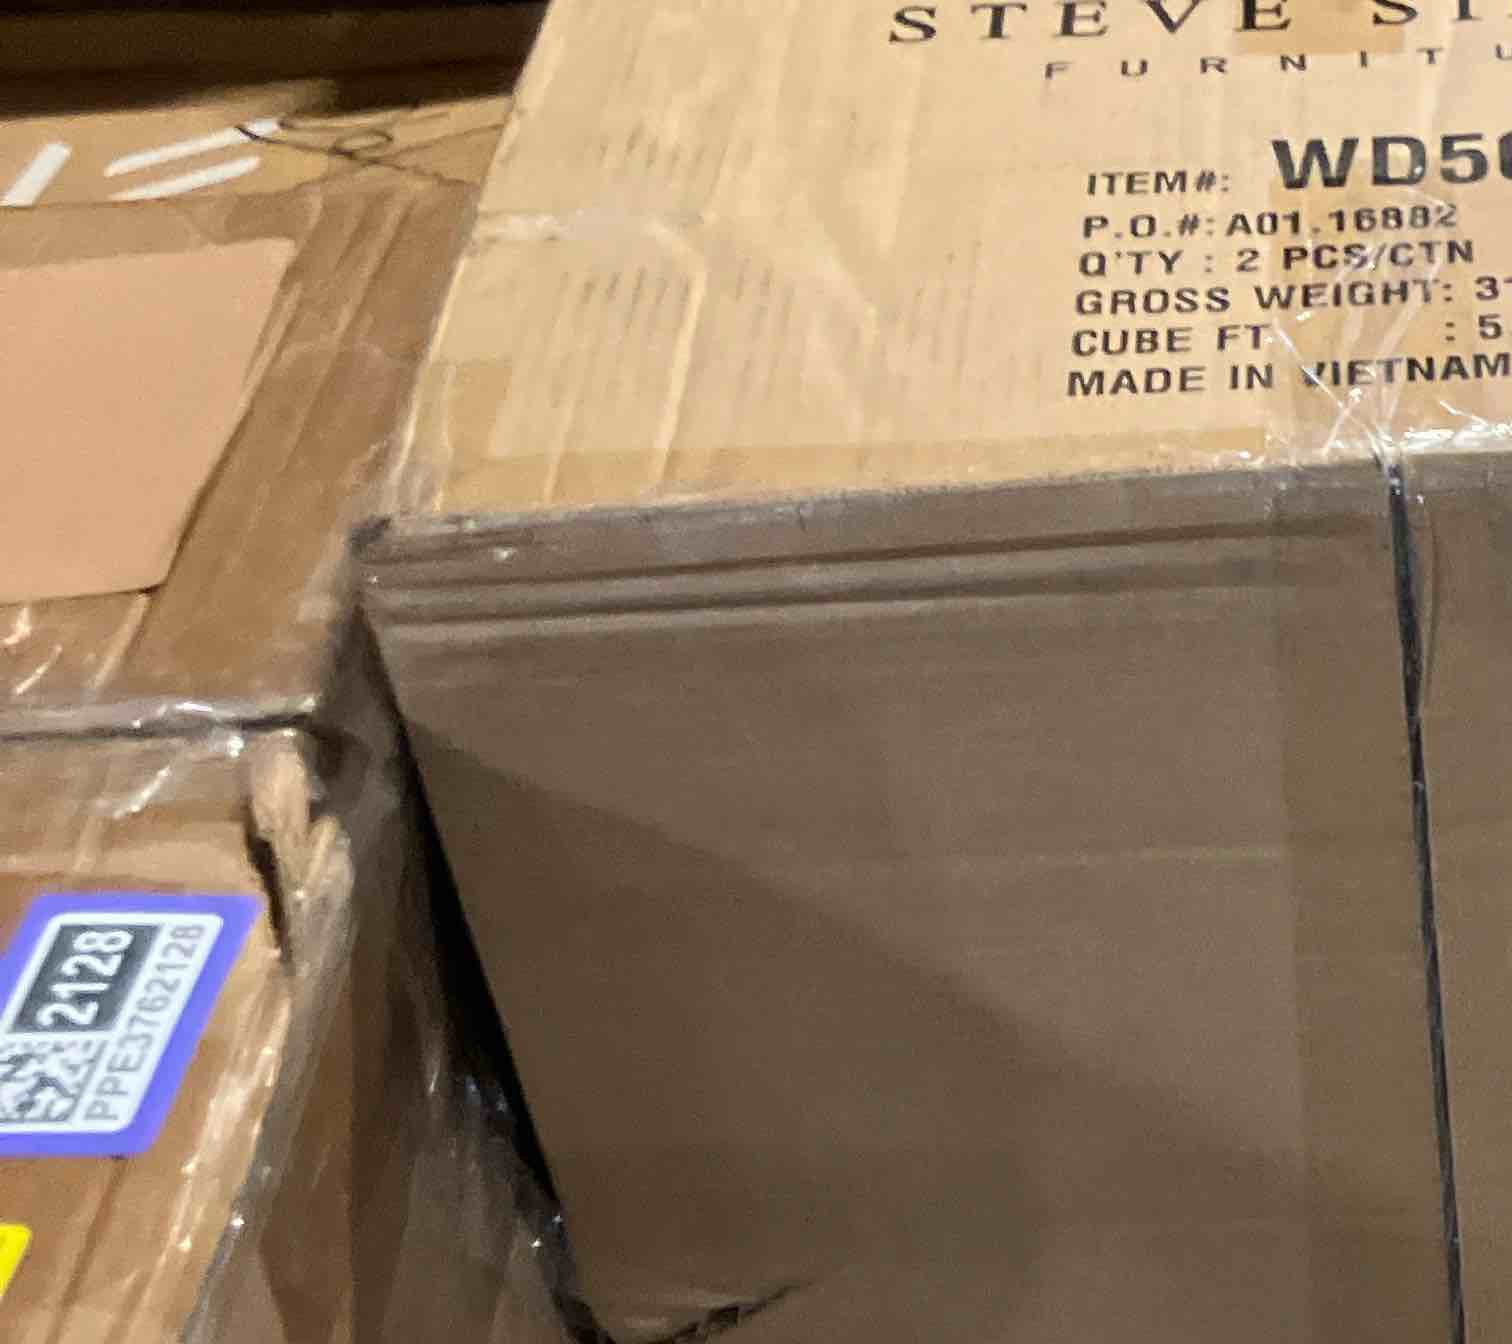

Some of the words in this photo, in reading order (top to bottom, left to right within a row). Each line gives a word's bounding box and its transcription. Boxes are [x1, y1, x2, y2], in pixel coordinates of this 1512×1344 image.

[1086, 169, 1233, 196] ITEM#:
[1225, 203, 1458, 237] A01.16882
[1235, 249, 1260, 273] 2
[1281, 239, 1475, 270] PCS/CTN
[1074, 286, 1232, 316] GROSS
[1072, 325, 1193, 357] CUBE
[1215, 323, 1272, 352] FT
[1067, 365, 1205, 398] MADE
[1229, 363, 1274, 390] IN
[34, 929, 135, 1027] 2128
[82, 925, 206, 1121] PPE3762128
